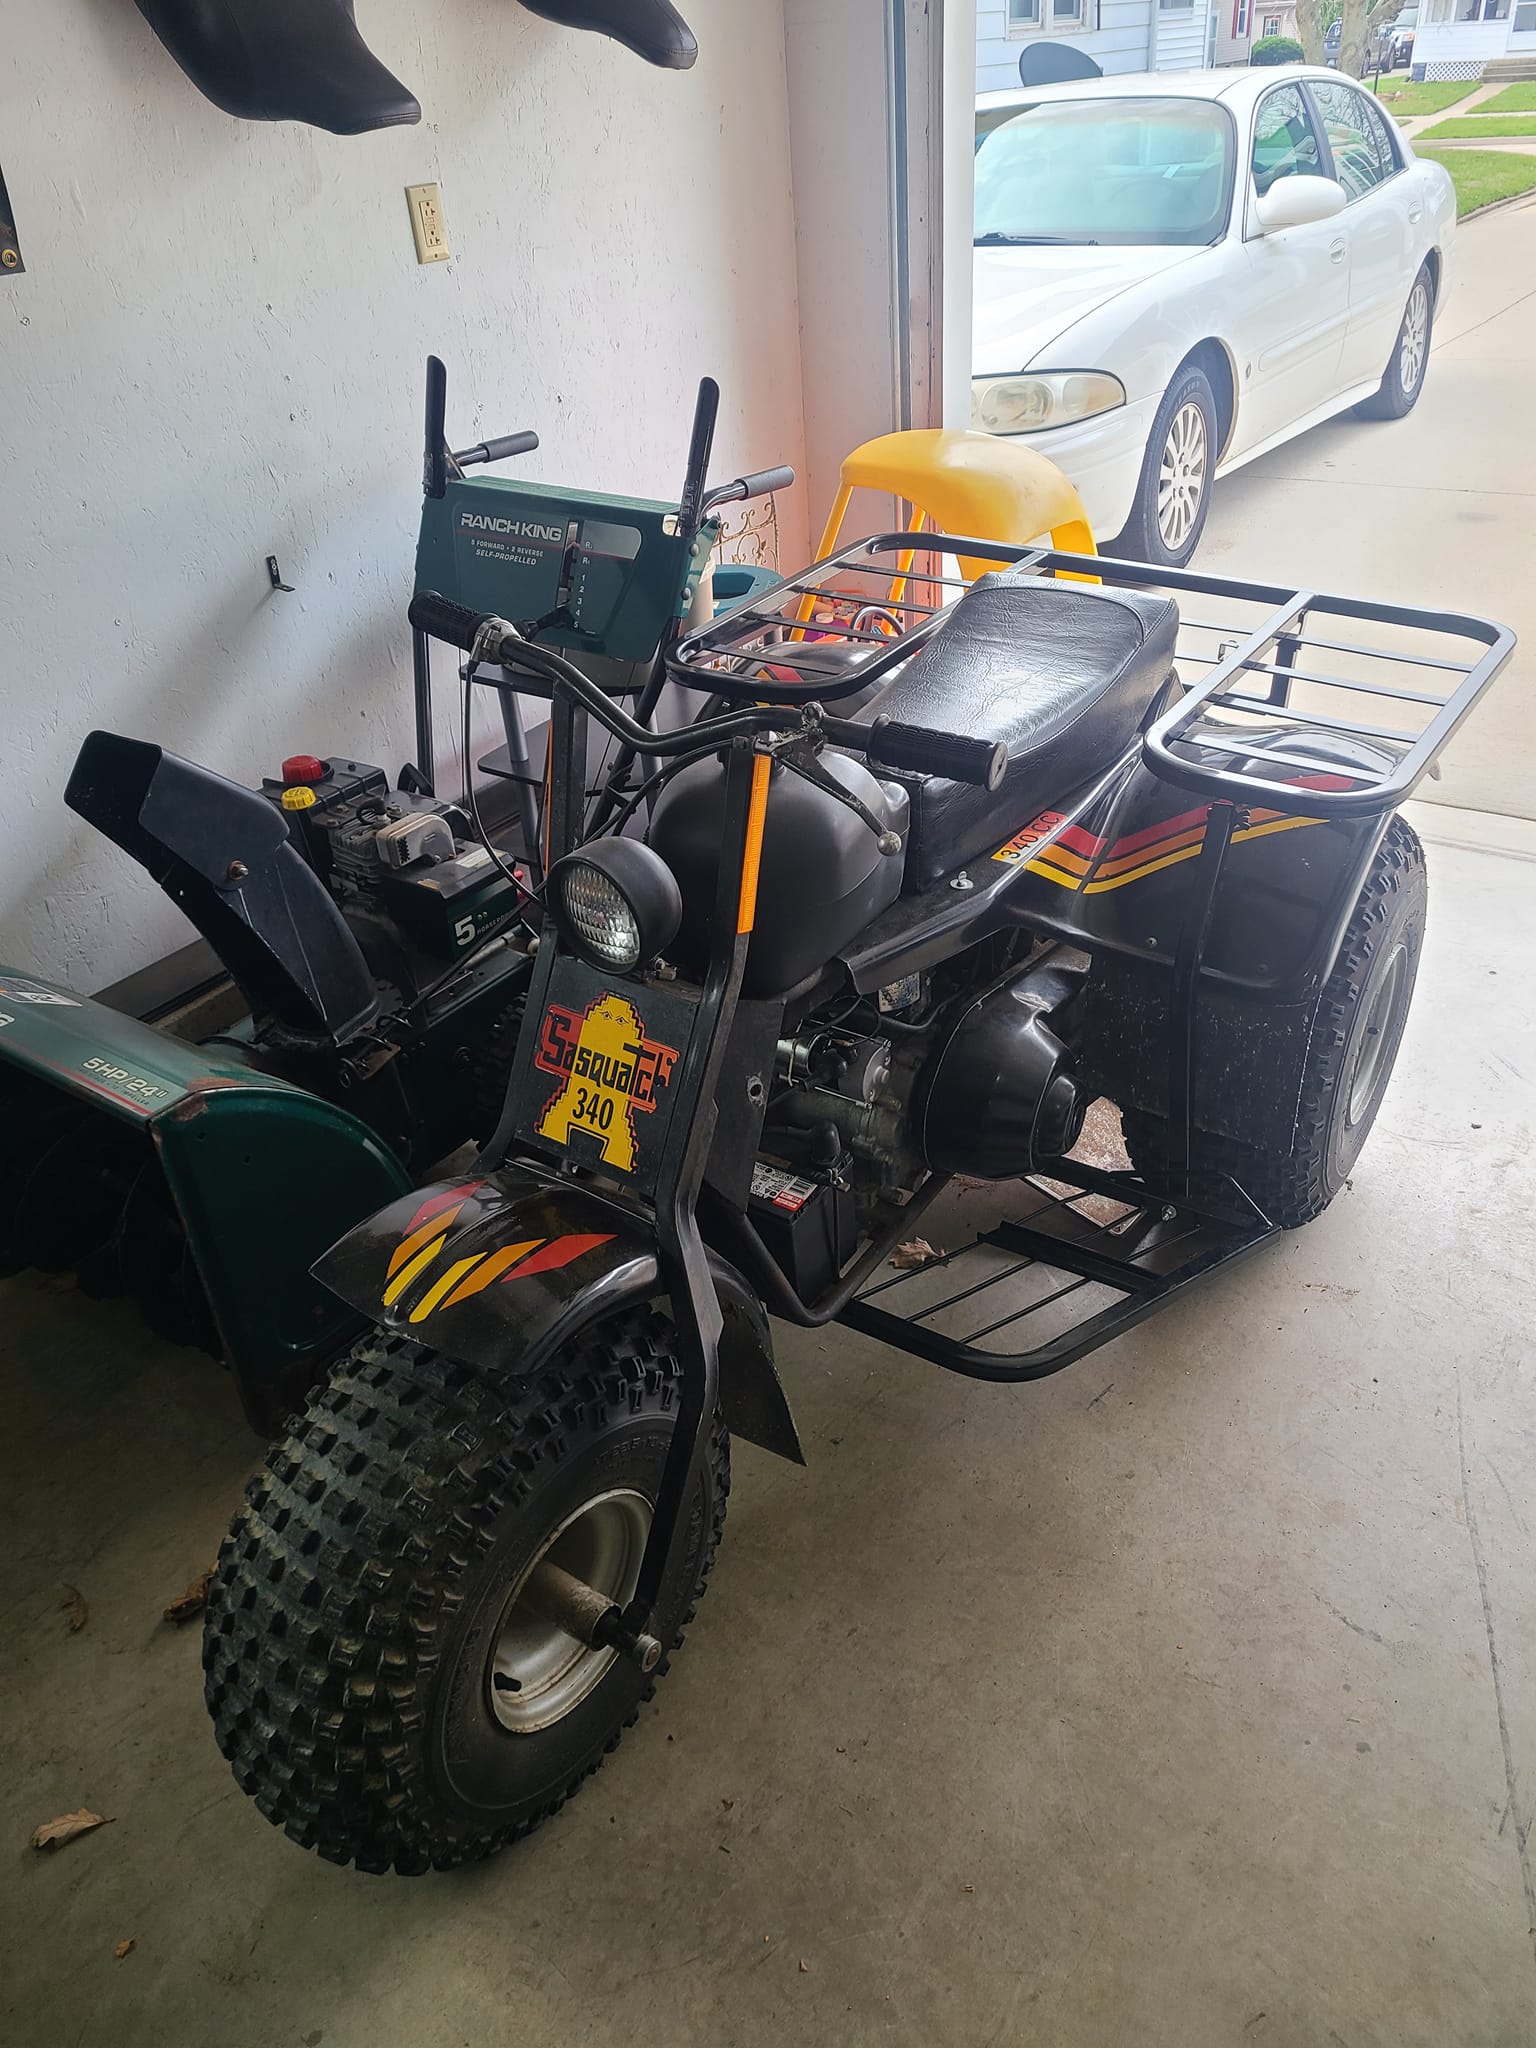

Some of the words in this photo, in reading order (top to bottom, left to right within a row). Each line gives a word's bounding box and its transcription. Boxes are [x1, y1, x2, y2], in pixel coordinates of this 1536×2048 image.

[460, 512, 520, 535] RANCH
[521, 522, 563, 542] KING
[475, 549, 537, 566] SELF-PROPELLED
[476, 540, 505, 551] FORWARD
[517, 547, 544, 557] REVERSE
[1000, 834, 1039, 859] 340
[1030, 814, 1060, 833] CC
[454, 915, 476, 946] 5
[82, 1056, 168, 1098] 5HP/24"
[572, 1087, 615, 1131] 340
